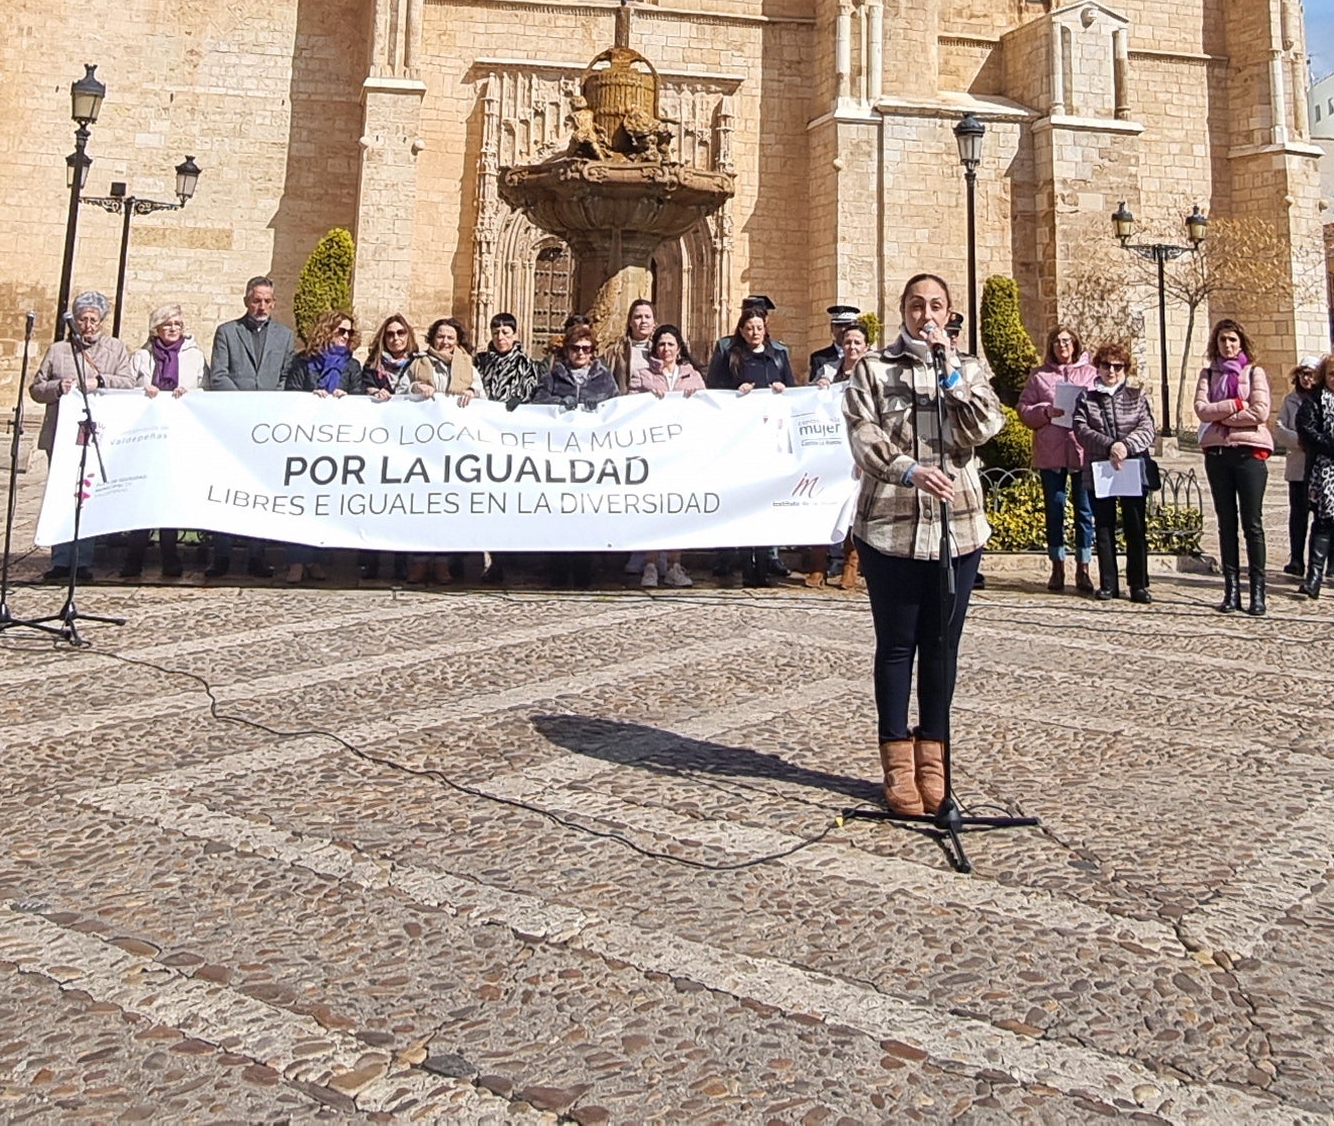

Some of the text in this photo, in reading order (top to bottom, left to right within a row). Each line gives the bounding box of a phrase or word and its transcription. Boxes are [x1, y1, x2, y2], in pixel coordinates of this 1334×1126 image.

[251, 422, 683, 453] CONSEJO LOCAL DE LA MUJER
[799, 423, 841, 437] mujer
[283, 453, 649, 486] POR LA IGUALDAD
[207, 485, 720, 516] LIBRES E IGUALES EN LA DIVERSIDAD
